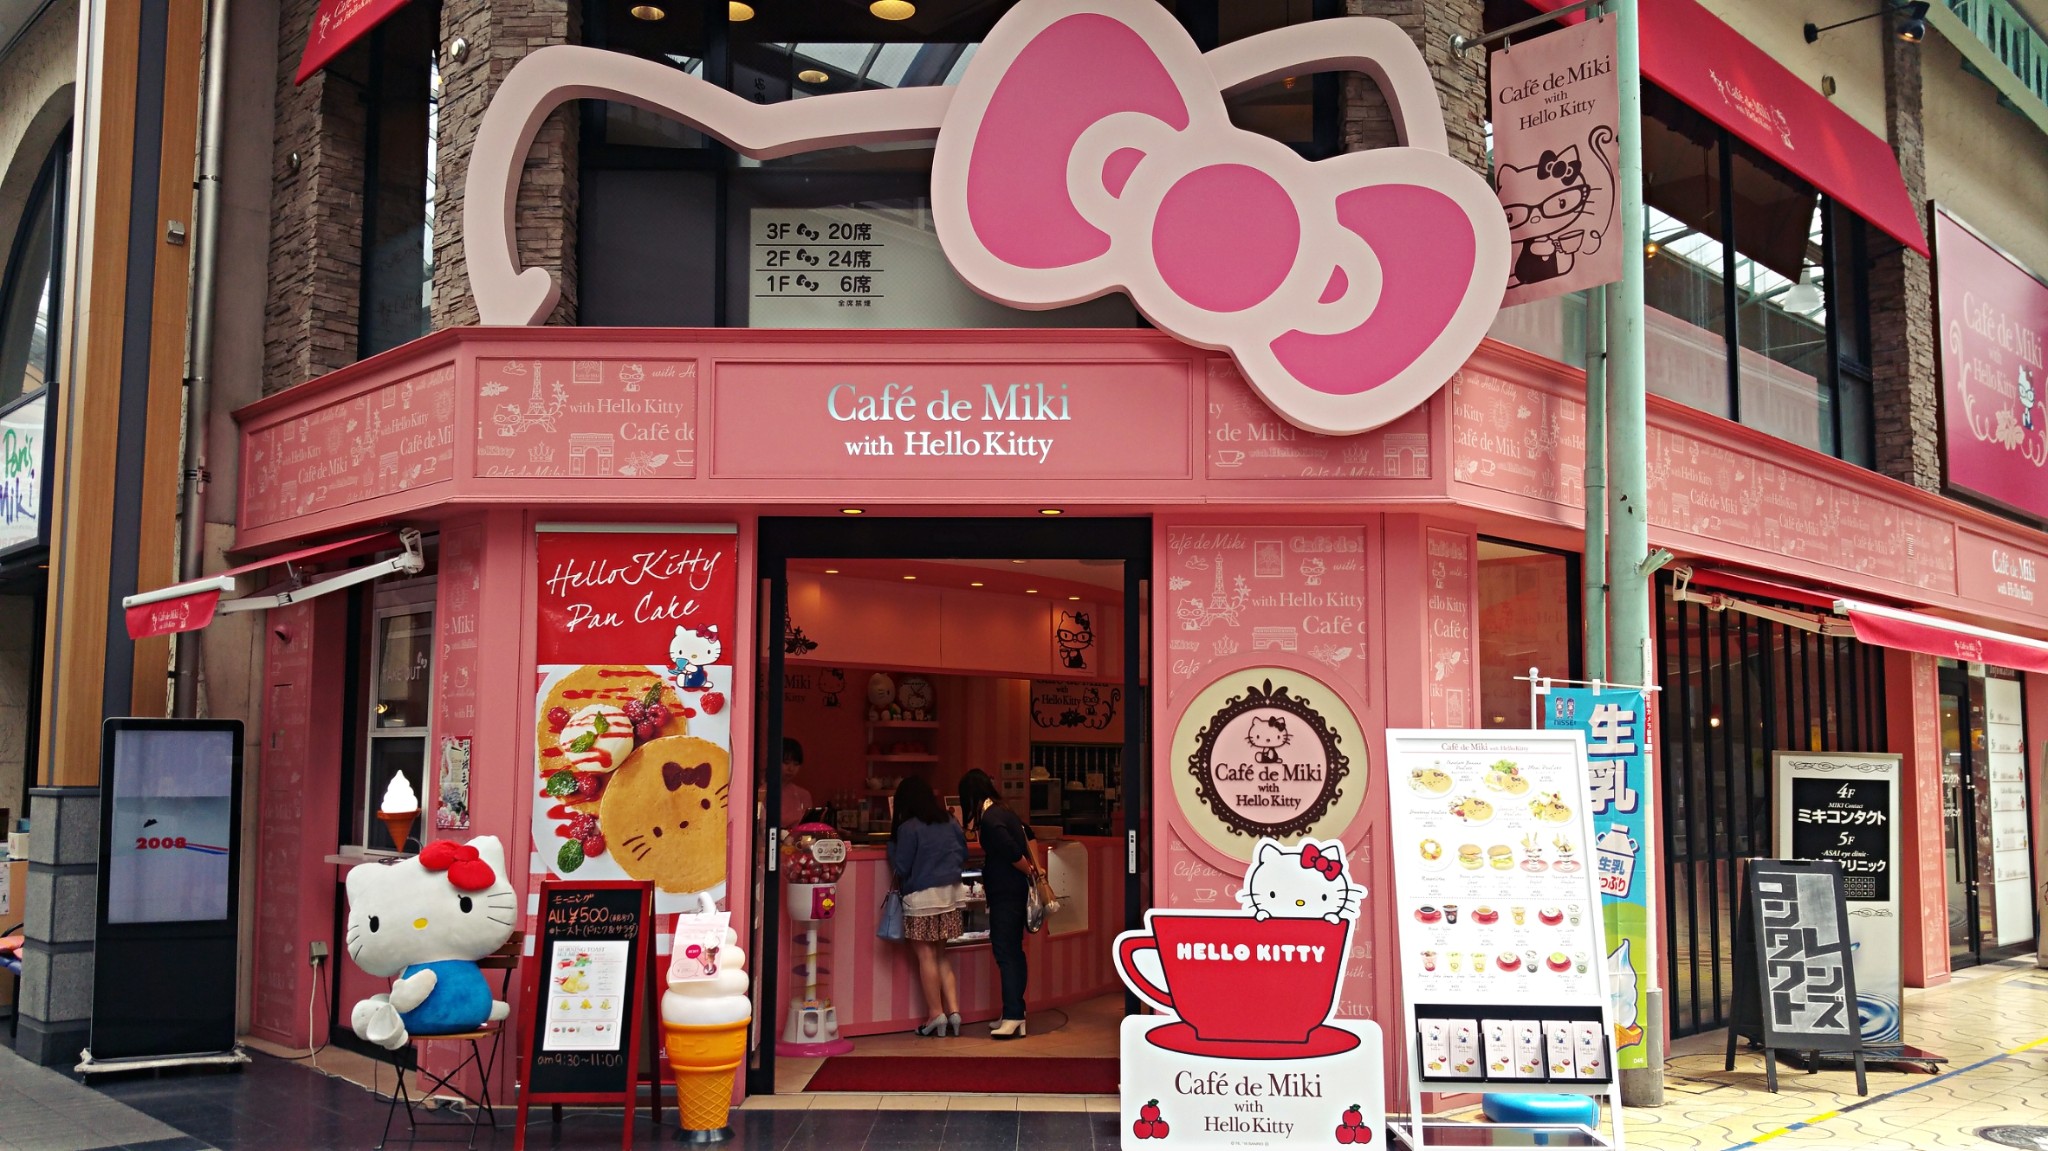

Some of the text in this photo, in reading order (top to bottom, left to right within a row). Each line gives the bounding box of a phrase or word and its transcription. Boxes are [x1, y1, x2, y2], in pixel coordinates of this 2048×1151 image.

[1499, 55, 1612, 105] Café de Miki
[1544, 91, 1568, 104] with
[1519, 99, 1596, 131] Hello Kitty
[767, 222, 872, 242] 3F 20席
[766, 249, 872, 269] 2F 24席
[767, 275, 872, 294] 1F 6席
[1963, 291, 2043, 371] Café de Miki
[569, 398, 684, 418] with Hello Kitty
[827, 382, 1071, 421] Café de Miki
[1463, 404, 1484, 426] Kitty
[391, 418, 410, 435] Hello
[620, 422, 670, 442] Café
[1216, 423, 1296, 442] de Miki
[3, 428, 33, 478] Paris
[400, 433, 423, 457] Café
[424, 431, 436, 450] de
[845, 436, 894, 456] with
[1480, 433, 1494, 452] de
[1495, 436, 1521, 459] Miki
[298, 464, 316, 485] Café
[317, 460, 327, 478] de
[328, 455, 348, 476] Miki
[1691, 489, 1738, 515] Café de Miki
[1779, 513, 1794, 529] Café
[1194, 533, 1247, 550] de Miki
[546, 548, 722, 598] Hello Kitty
[1992, 549, 2009, 575] Café
[2019, 557, 2036, 583] Miki
[1252, 591, 1365, 611] with Hello Kitty
[1447, 596, 1467, 617] Kitty
[566, 590, 700, 633] Pan Cake
[452, 614, 475, 635] Miki
[1303, 615, 1352, 635] Café
[1434, 618, 1460, 639] Café
[1173, 659, 1200, 679] Café
[784, 674, 811, 689] Miki
[1441, 743, 1458, 751] Café
[1471, 742, 1488, 751] Miki
[1588, 703, 1637, 814] 生乳
[1215, 762, 1323, 782] Café de Miki
[1258, 783, 1280, 793] with
[1837, 783, 1855, 799] 4F
[1798, 808, 1886, 825] ミキコンタクト
[136, 837, 187, 850] 2008
[1837, 832, 1855, 846] 5F
[1174, 860, 1202, 881] Café
[1599, 856, 1625, 875] 生乳
[552, 893, 595, 905] モーニング
[1177, 942, 1325, 963] HELLO KITTY
[1758, 873, 1806, 1026] コンタクト
[1802, 927, 1848, 1029] レンズ
[1175, 1070, 1322, 1098] Café de Miki
[1234, 1100, 1263, 1113] with
